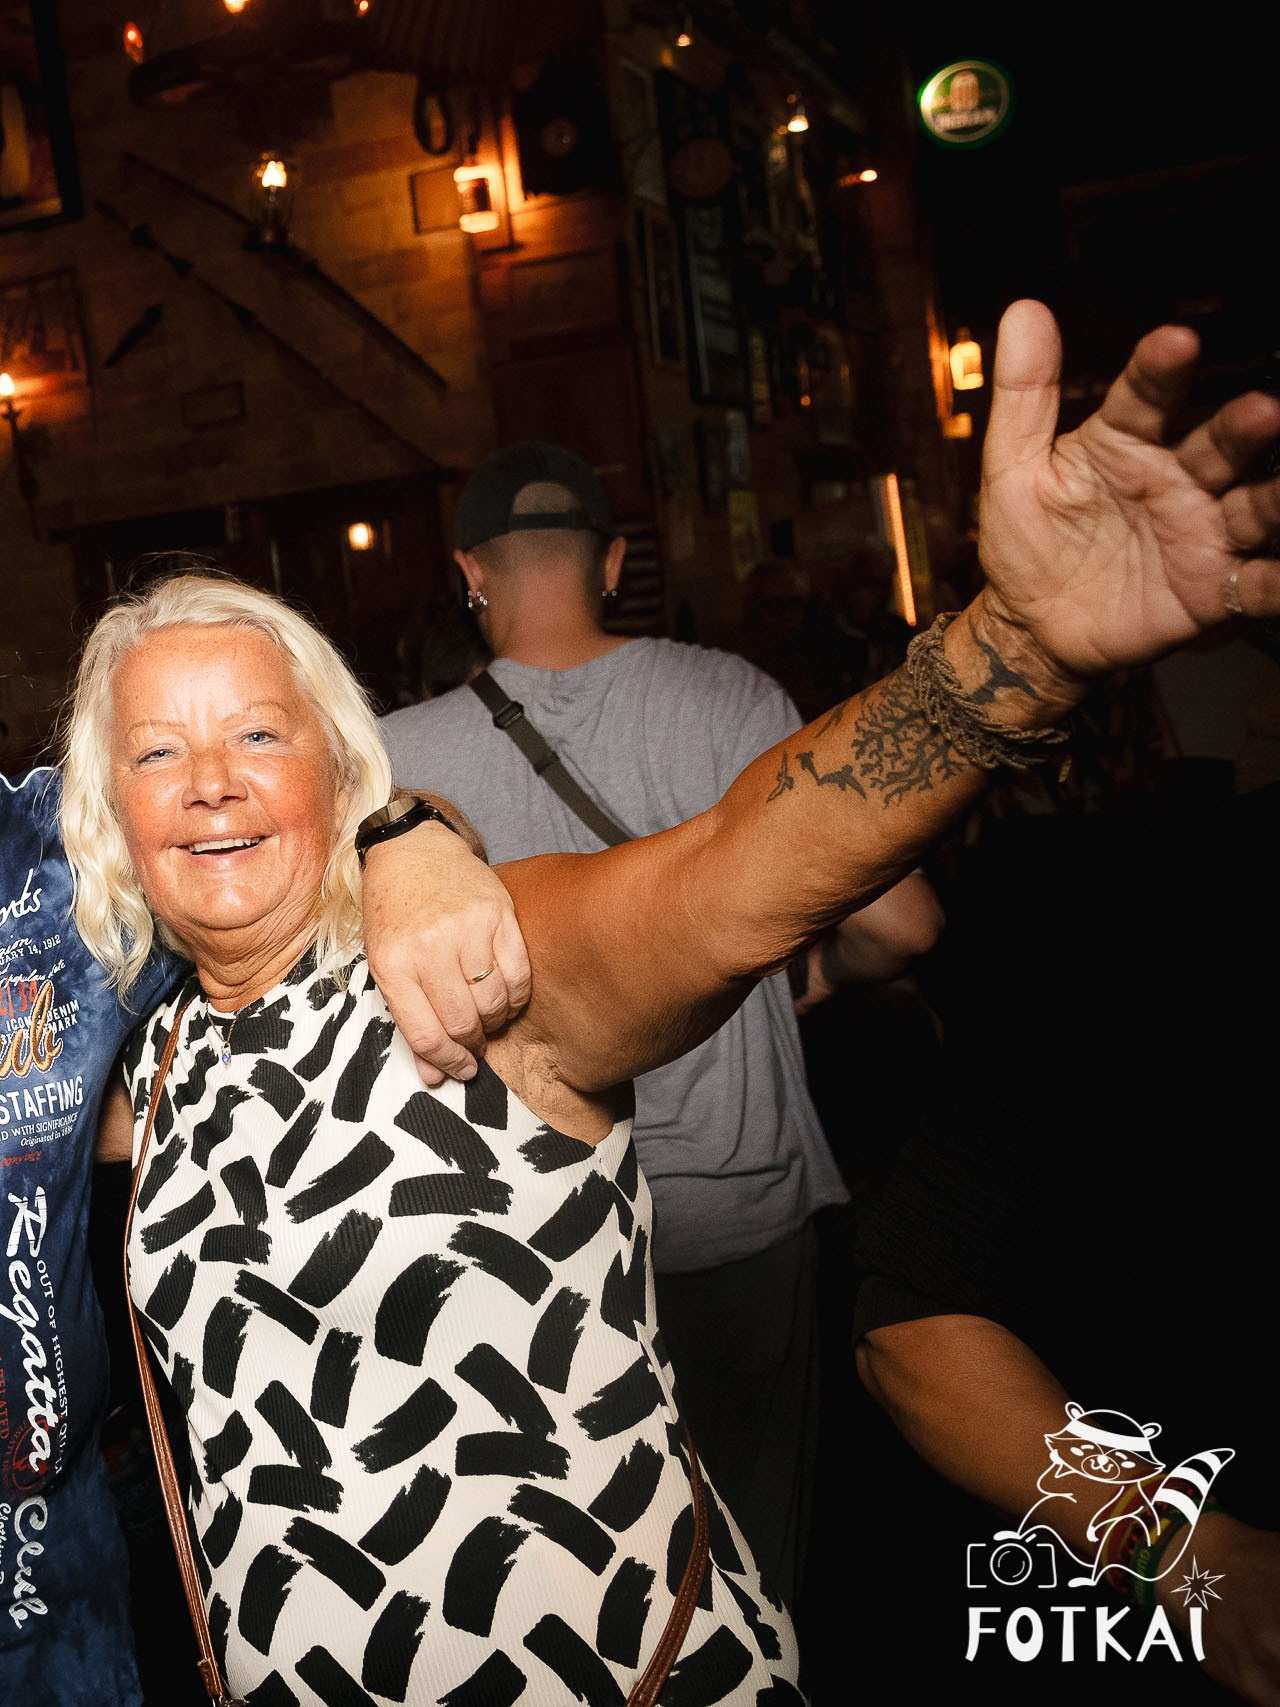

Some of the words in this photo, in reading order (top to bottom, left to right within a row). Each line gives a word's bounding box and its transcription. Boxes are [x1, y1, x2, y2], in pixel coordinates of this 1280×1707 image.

[27, 944, 42, 955] 14,
[42, 934, 61, 950] 1912
[10, 1123, 35, 1137] WITH
[35, 1112, 79, 1133] SIGNIFICANCE
[20, 1131, 54, 1147] Originated
[54, 1130, 61, 1139] in
[37, 1259, 54, 1299] OUT
[47, 1307, 57, 1329] OF
[51, 1334, 69, 1417] HIGHEST
[8, 1495, 48, 1630] Club
